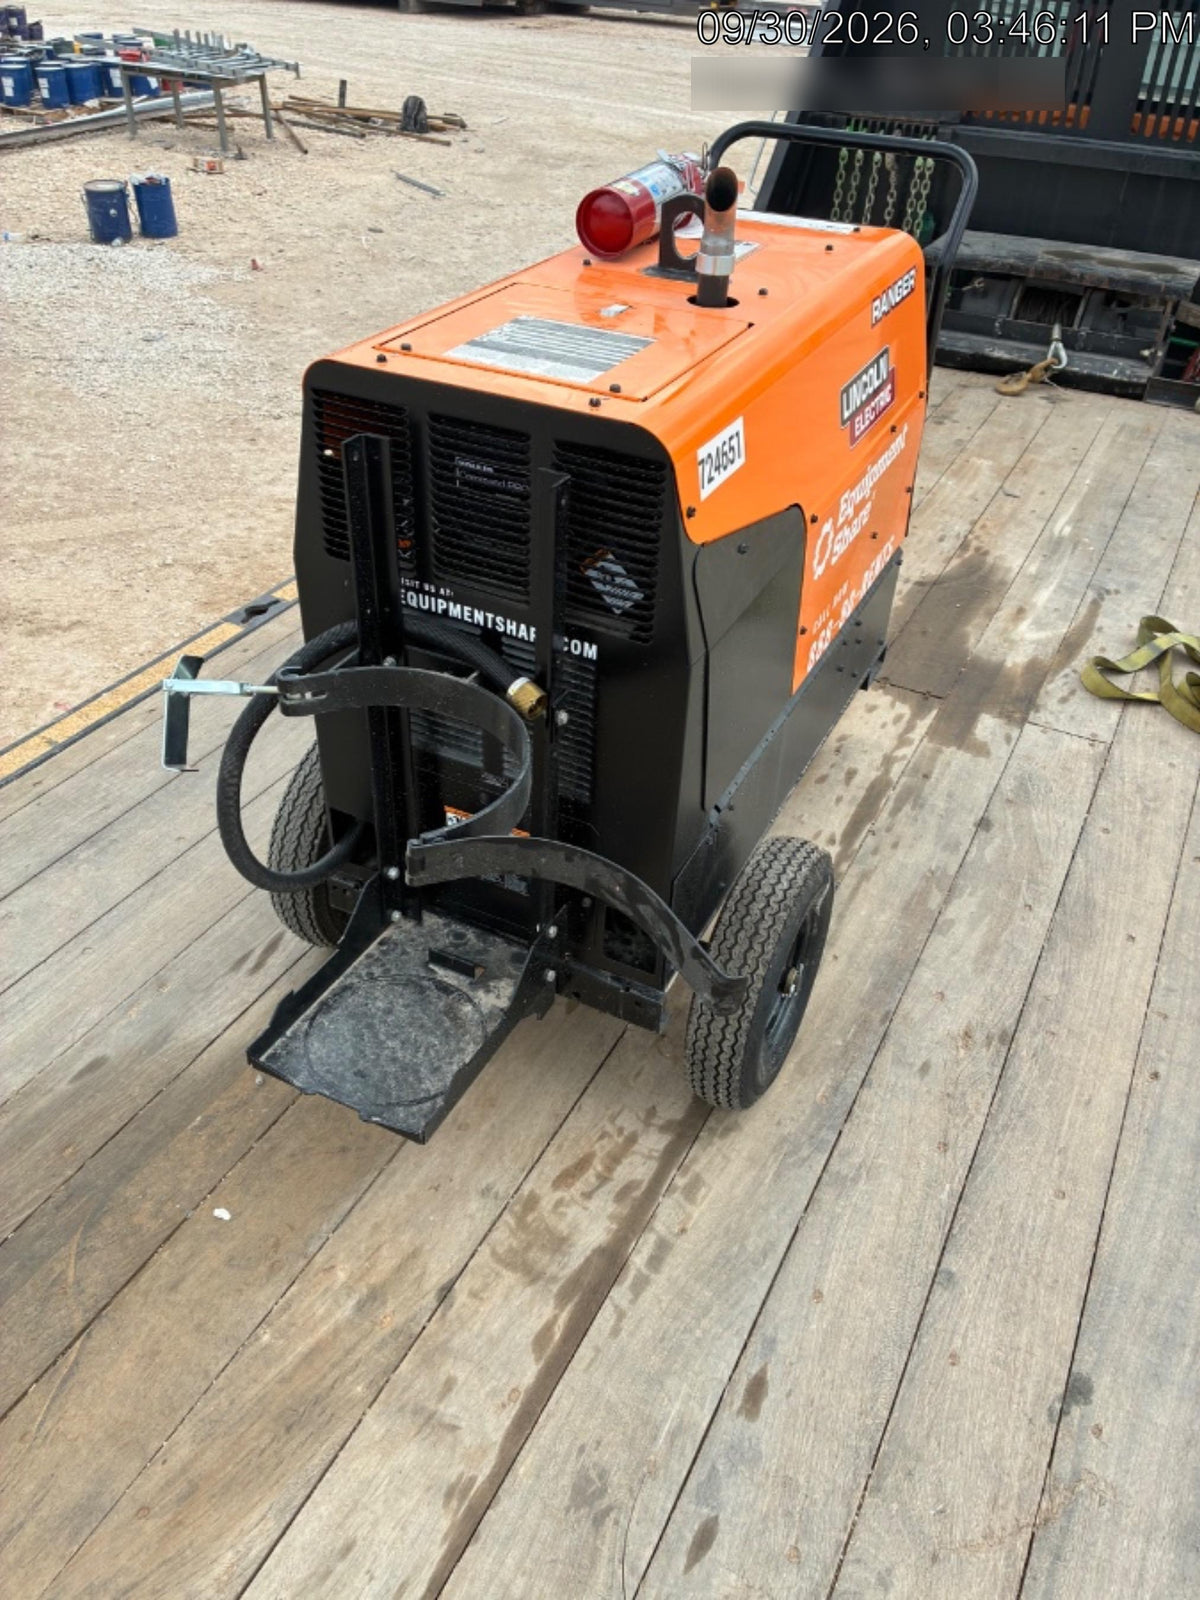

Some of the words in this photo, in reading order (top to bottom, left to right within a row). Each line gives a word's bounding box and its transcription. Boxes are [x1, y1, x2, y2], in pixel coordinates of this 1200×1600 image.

[871, 267, 916, 326] RANGER
[842, 351, 889, 421] LINCOLN
[854, 382, 892, 438] ELECTRIC
[698, 430, 741, 490] 724651
[837, 422, 908, 528] Equipment
[830, 500, 873, 566] Share
[401, 577, 420, 590] ISIT
